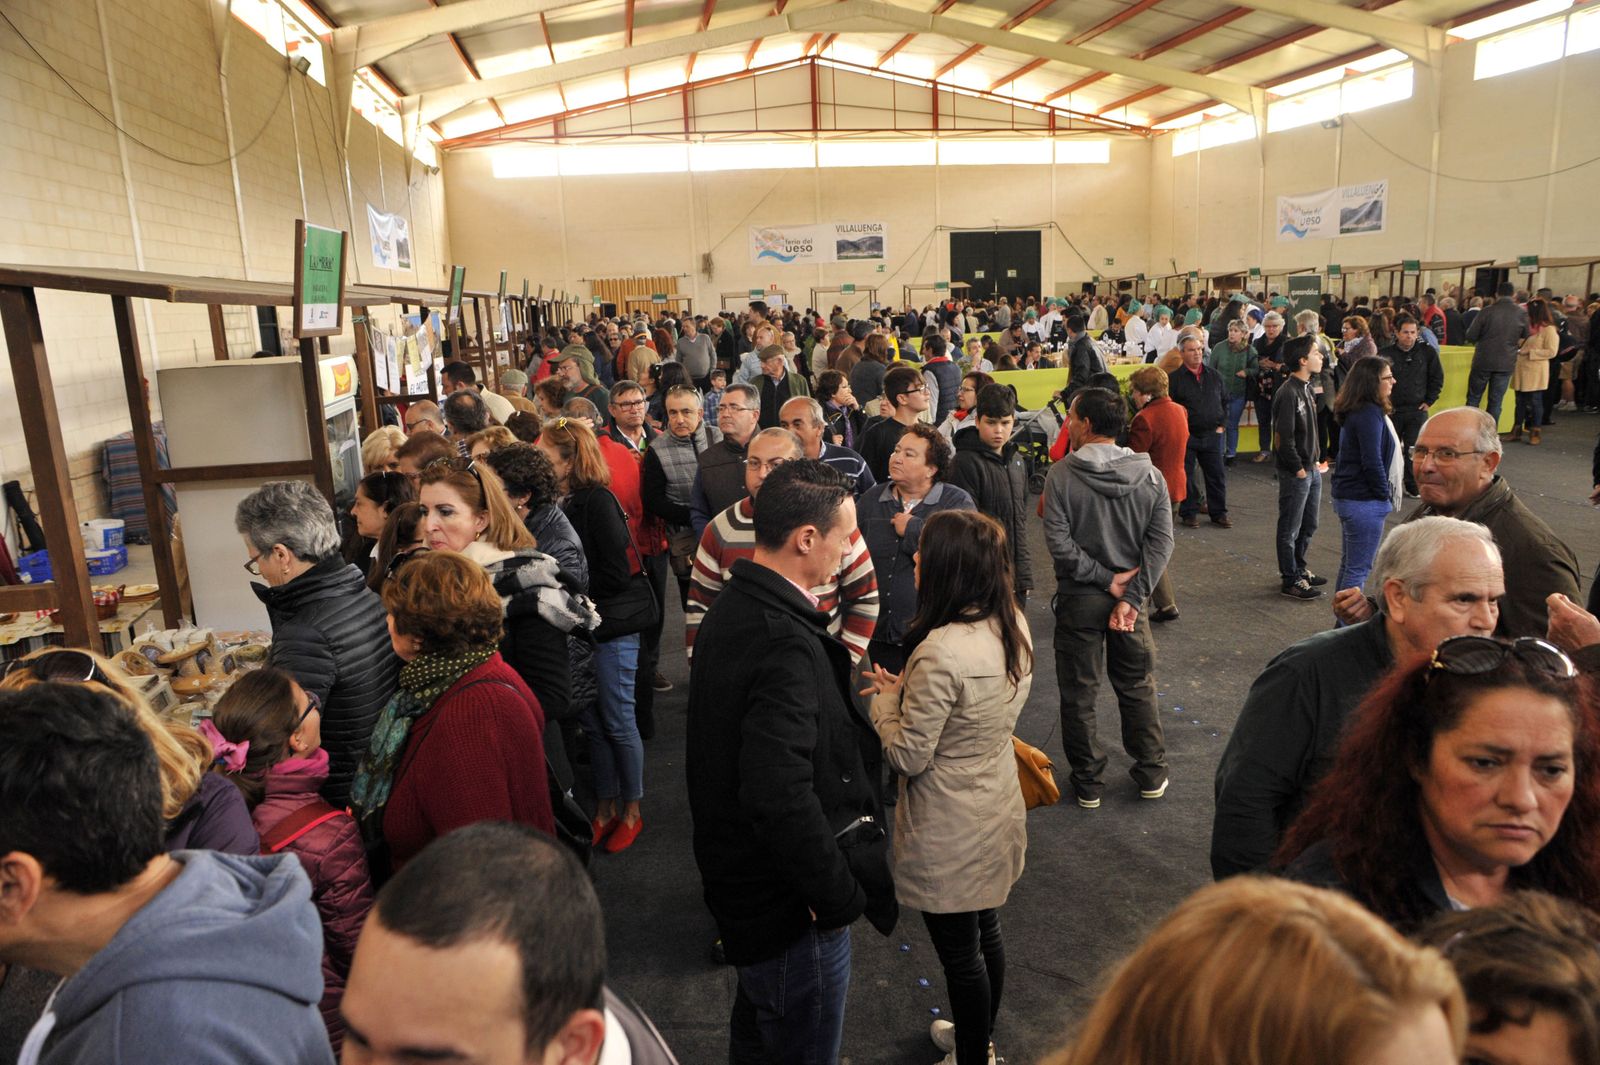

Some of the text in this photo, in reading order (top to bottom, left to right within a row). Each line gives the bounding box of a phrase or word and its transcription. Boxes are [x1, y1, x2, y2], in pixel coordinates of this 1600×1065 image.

[836, 223, 883, 233] VILLALUENGA
[785, 237, 813, 246] feria del
